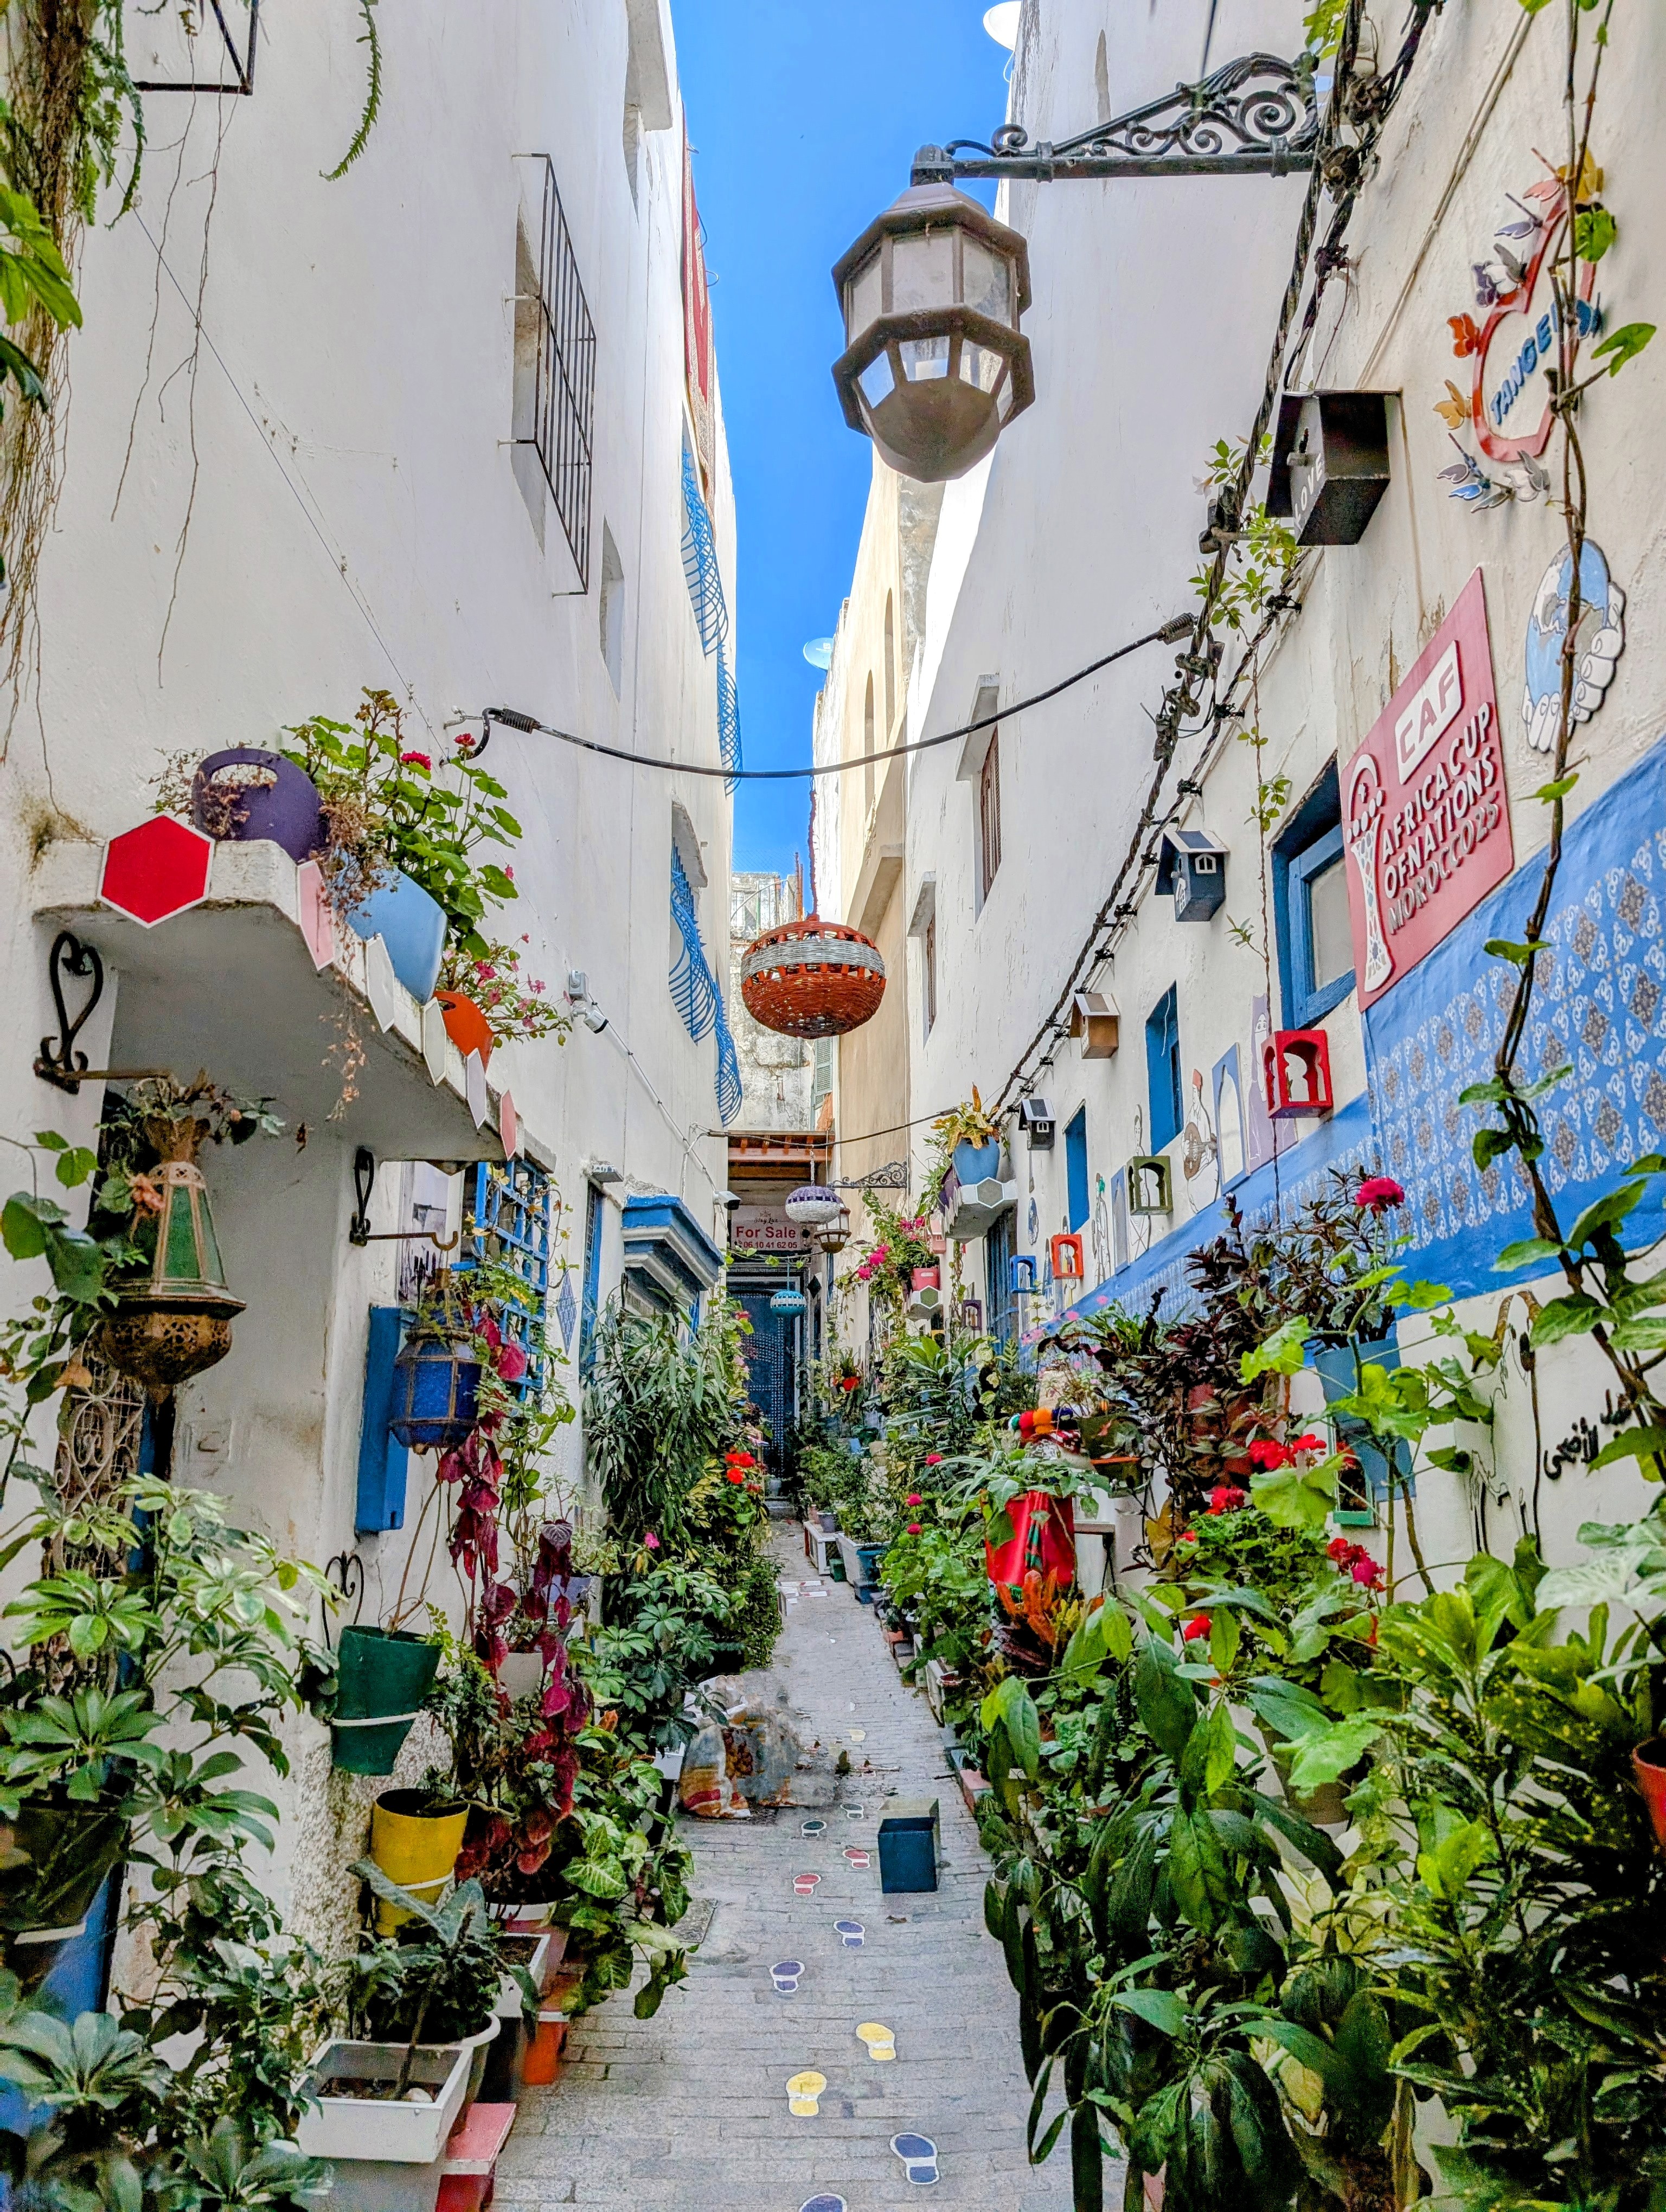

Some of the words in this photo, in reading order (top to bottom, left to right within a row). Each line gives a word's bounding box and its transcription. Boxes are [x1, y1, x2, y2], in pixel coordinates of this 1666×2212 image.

[1295, 453, 1322, 524] LOVE
[1400, 663, 1454, 764] CAF
[736, 1226, 760, 1238] For
[765, 1226, 796, 1238] Sale
